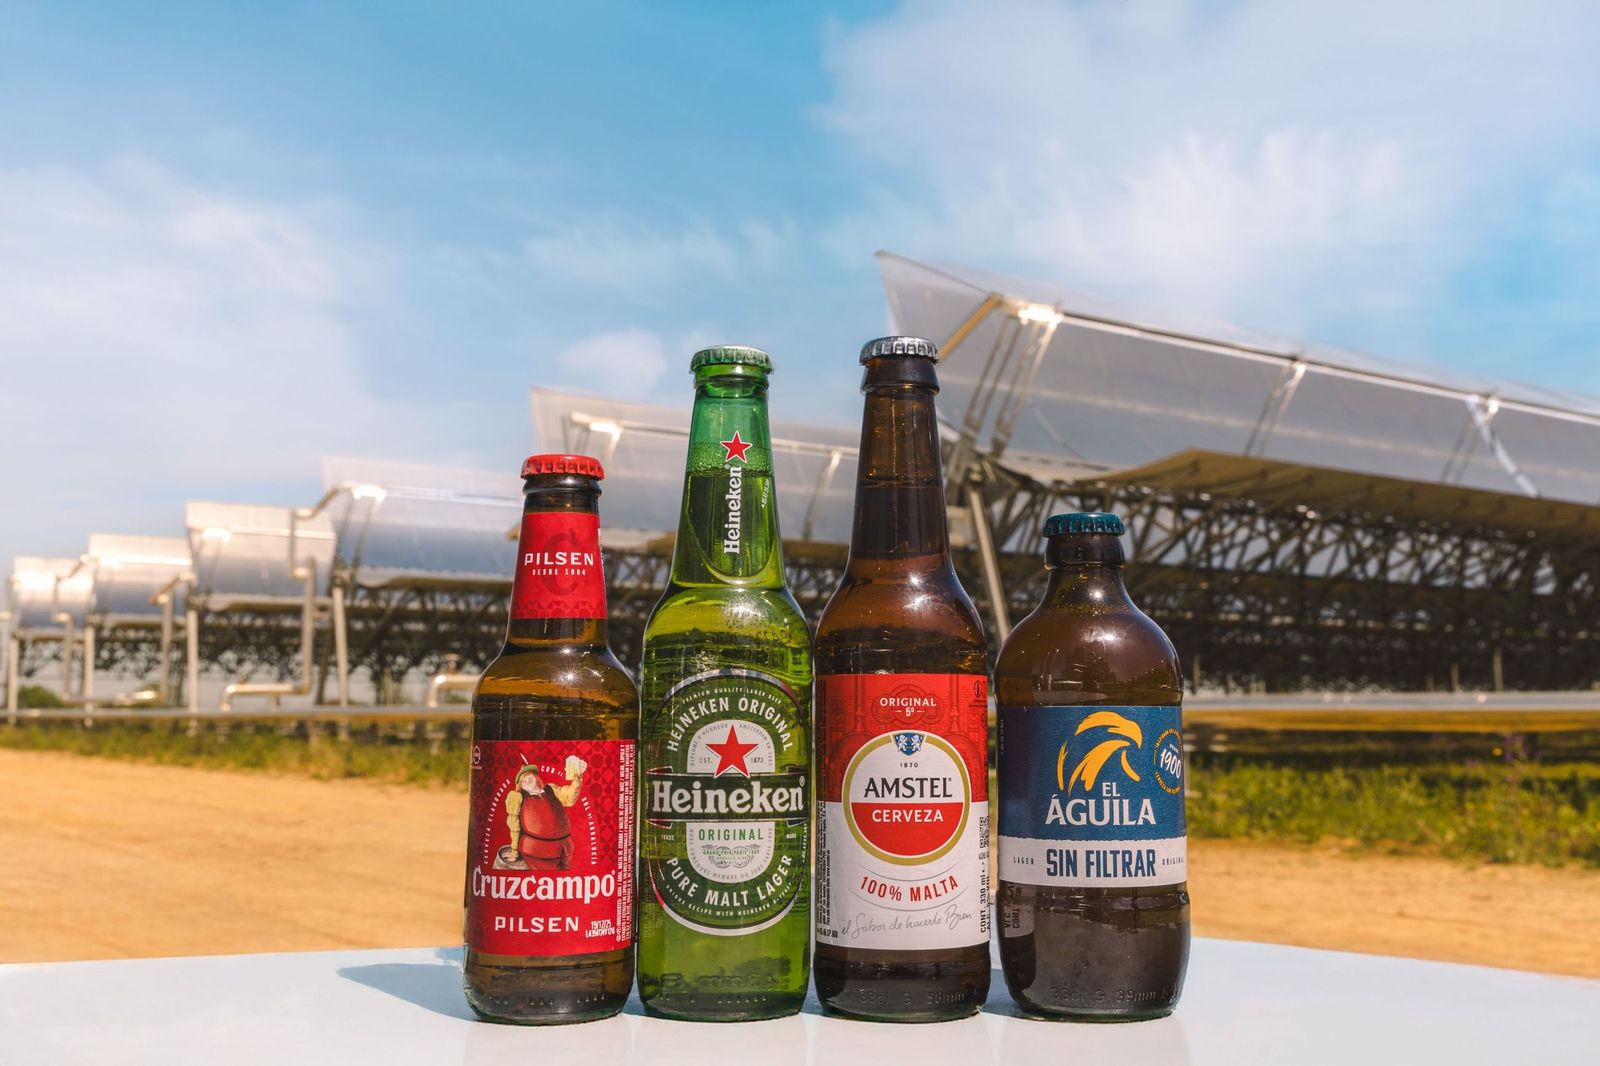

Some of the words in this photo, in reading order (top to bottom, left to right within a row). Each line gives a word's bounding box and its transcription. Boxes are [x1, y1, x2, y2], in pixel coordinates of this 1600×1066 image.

[724, 466, 742, 554] Heineken
[524, 552, 594, 566] PILSEN
[532, 568, 558, 576] DESDE
[880, 698, 936, 706] ORIGINAL
[666, 697, 729, 752] HEINEKEN
[738, 698, 793, 752] ORIGINAL
[1160, 748, 1182, 778] 1900
[652, 780, 804, 814] Heineken
[864, 778, 952, 798] AMSTEL
[1102, 782, 1120, 797] EL
[872, 810, 944, 822] CERVEZA
[1045, 794, 1157, 826] ÁGUILA
[698, 828, 764, 840] ORIGINAL
[1013, 856, 1034, 864] LAGER
[1046, 848, 1078, 878] SIN
[1086, 849, 1156, 878] FILTRAR
[472, 865, 616, 904] Cruzcampo
[666, 858, 698, 898] PURE
[704, 888, 748, 906] MALT
[757, 855, 792, 900] LAGER
[860, 876, 902, 902] 100%
[910, 875, 958, 902] MALTA
[495, 916, 579, 932] PILSEN
[889, 916, 902, 930] de
